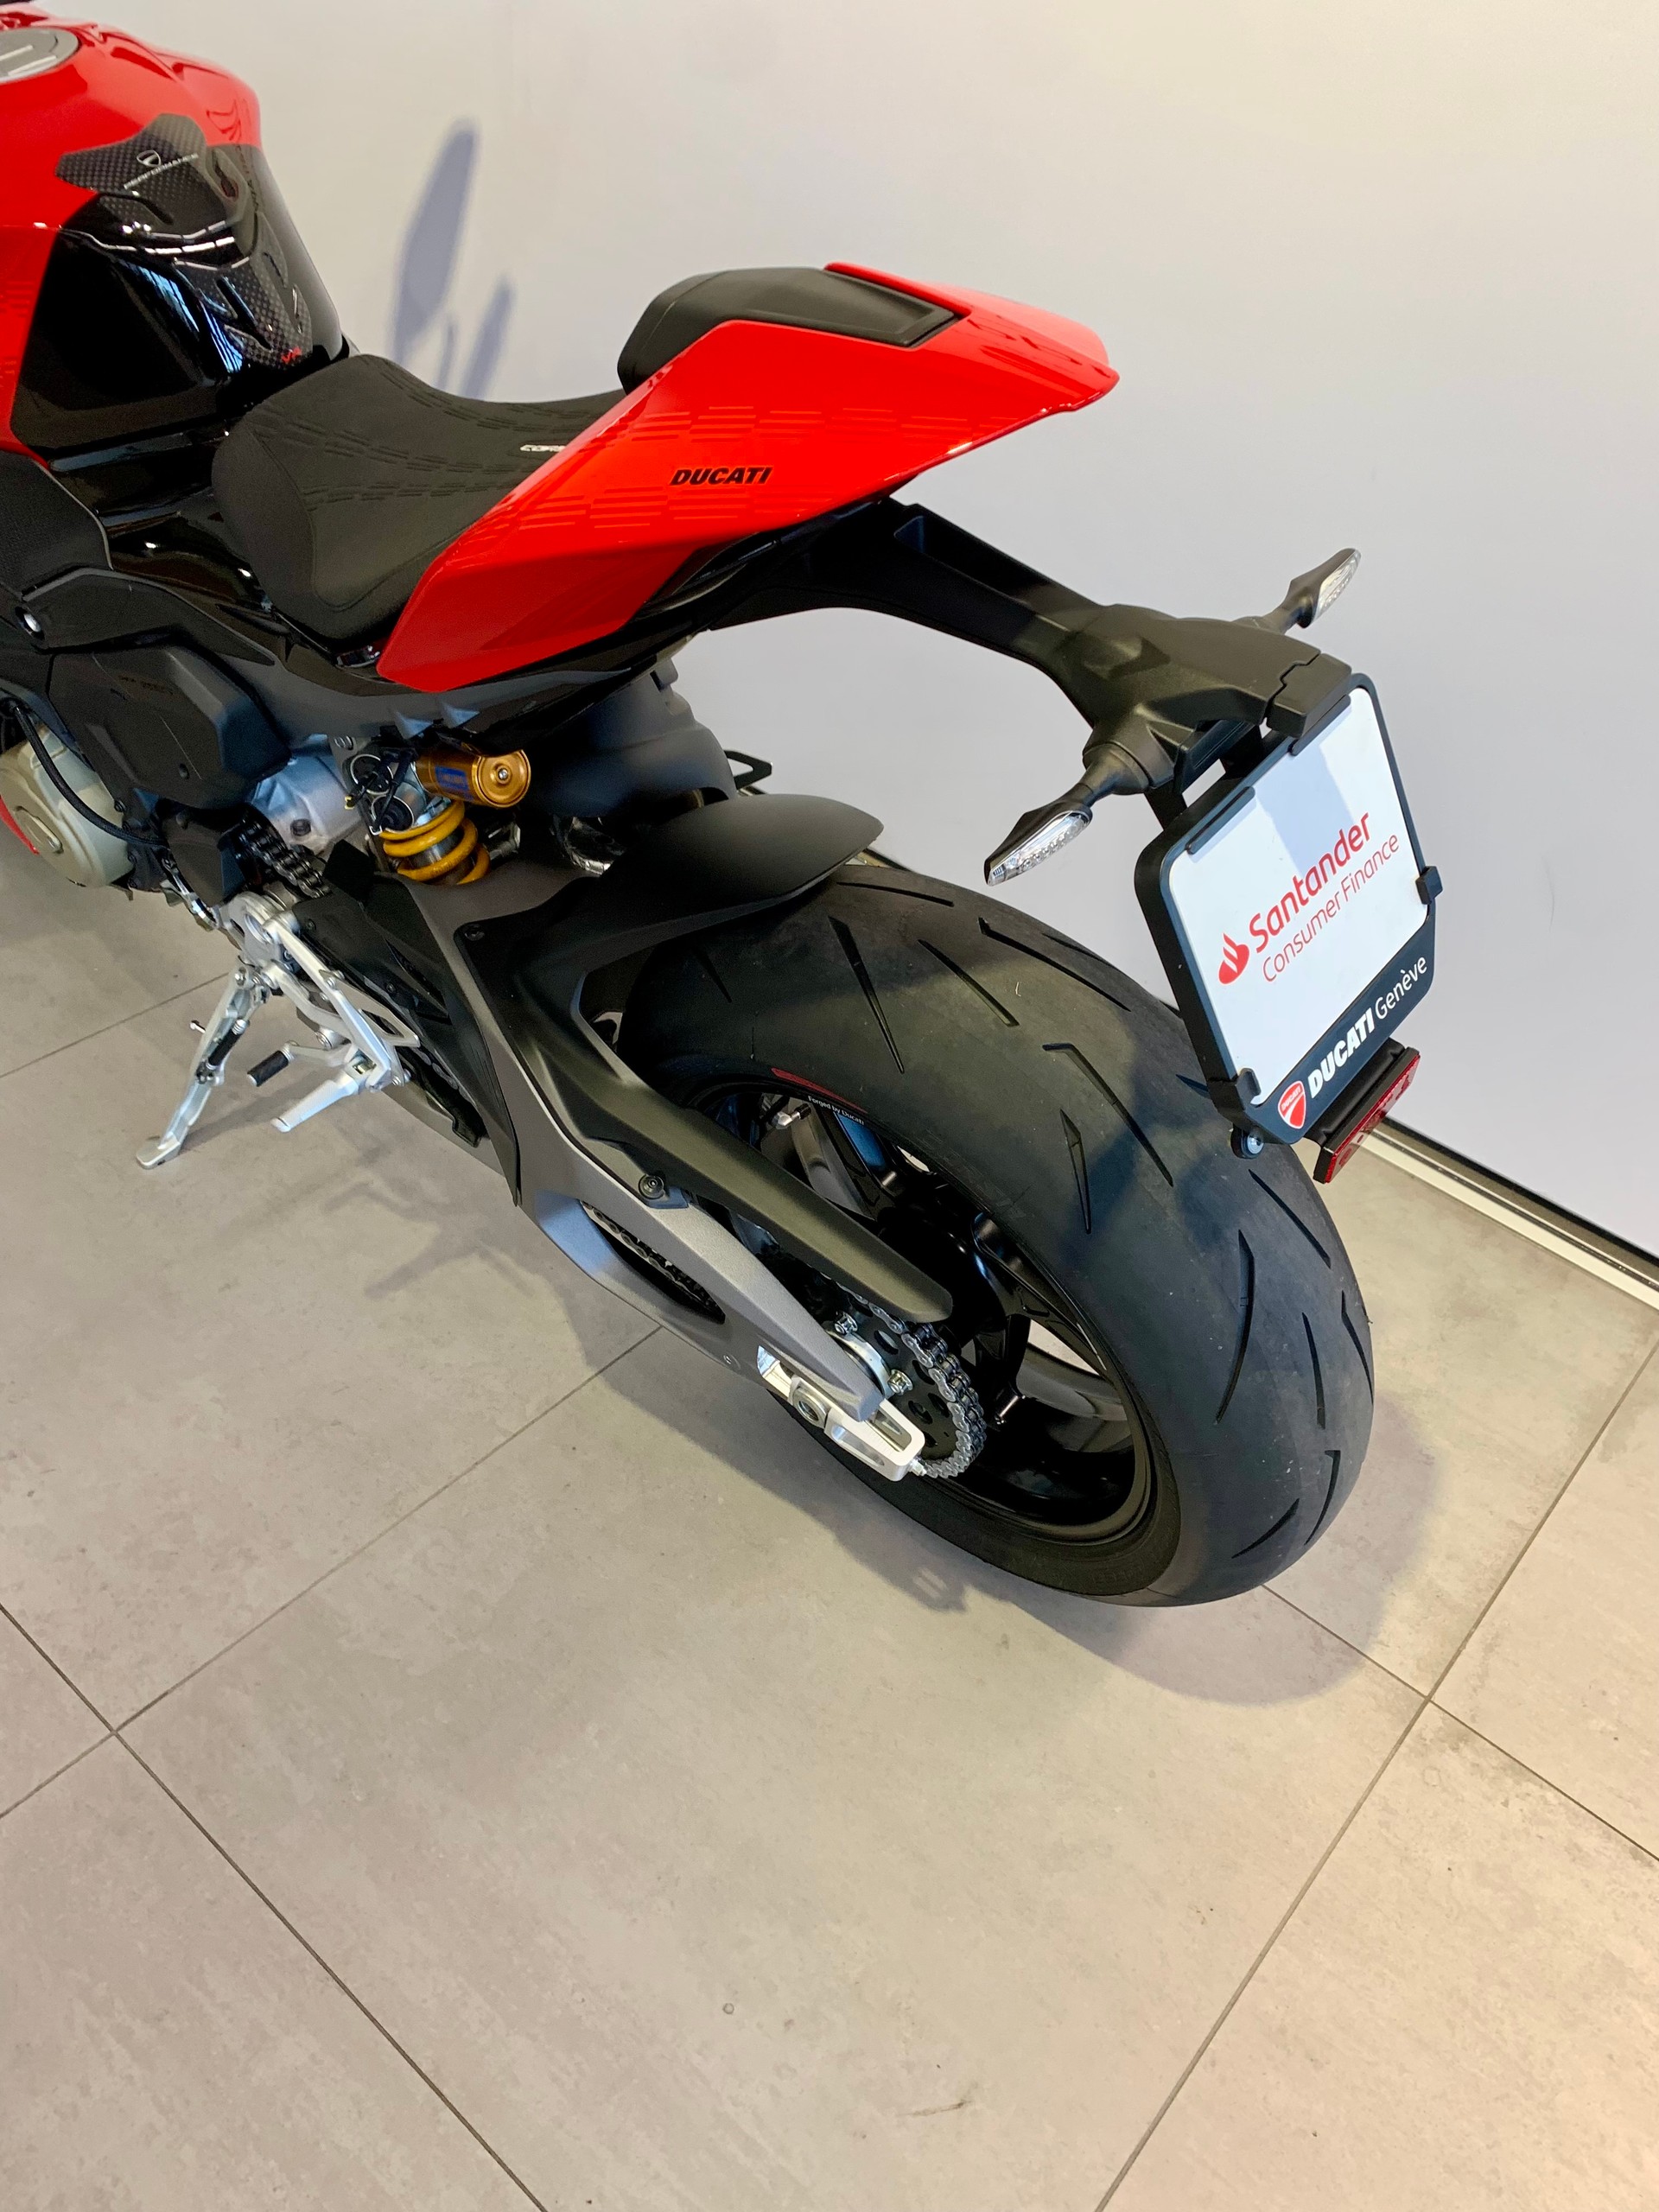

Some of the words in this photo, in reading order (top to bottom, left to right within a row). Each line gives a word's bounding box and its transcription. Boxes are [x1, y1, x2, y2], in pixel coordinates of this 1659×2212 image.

[669, 467, 773, 486] DUCATI
[1249, 812, 1370, 953] Santander
[1262, 891, 1341, 982] Consumer
[1341, 835, 1399, 902] Finance
[1307, 1007, 1375, 1098] DUCATI
[1375, 957, 1427, 1020] Genève
[808, 1096, 832, 1109] Forged
[832, 1105, 841, 1114] by
[842, 1109, 864, 1125] Ducati
